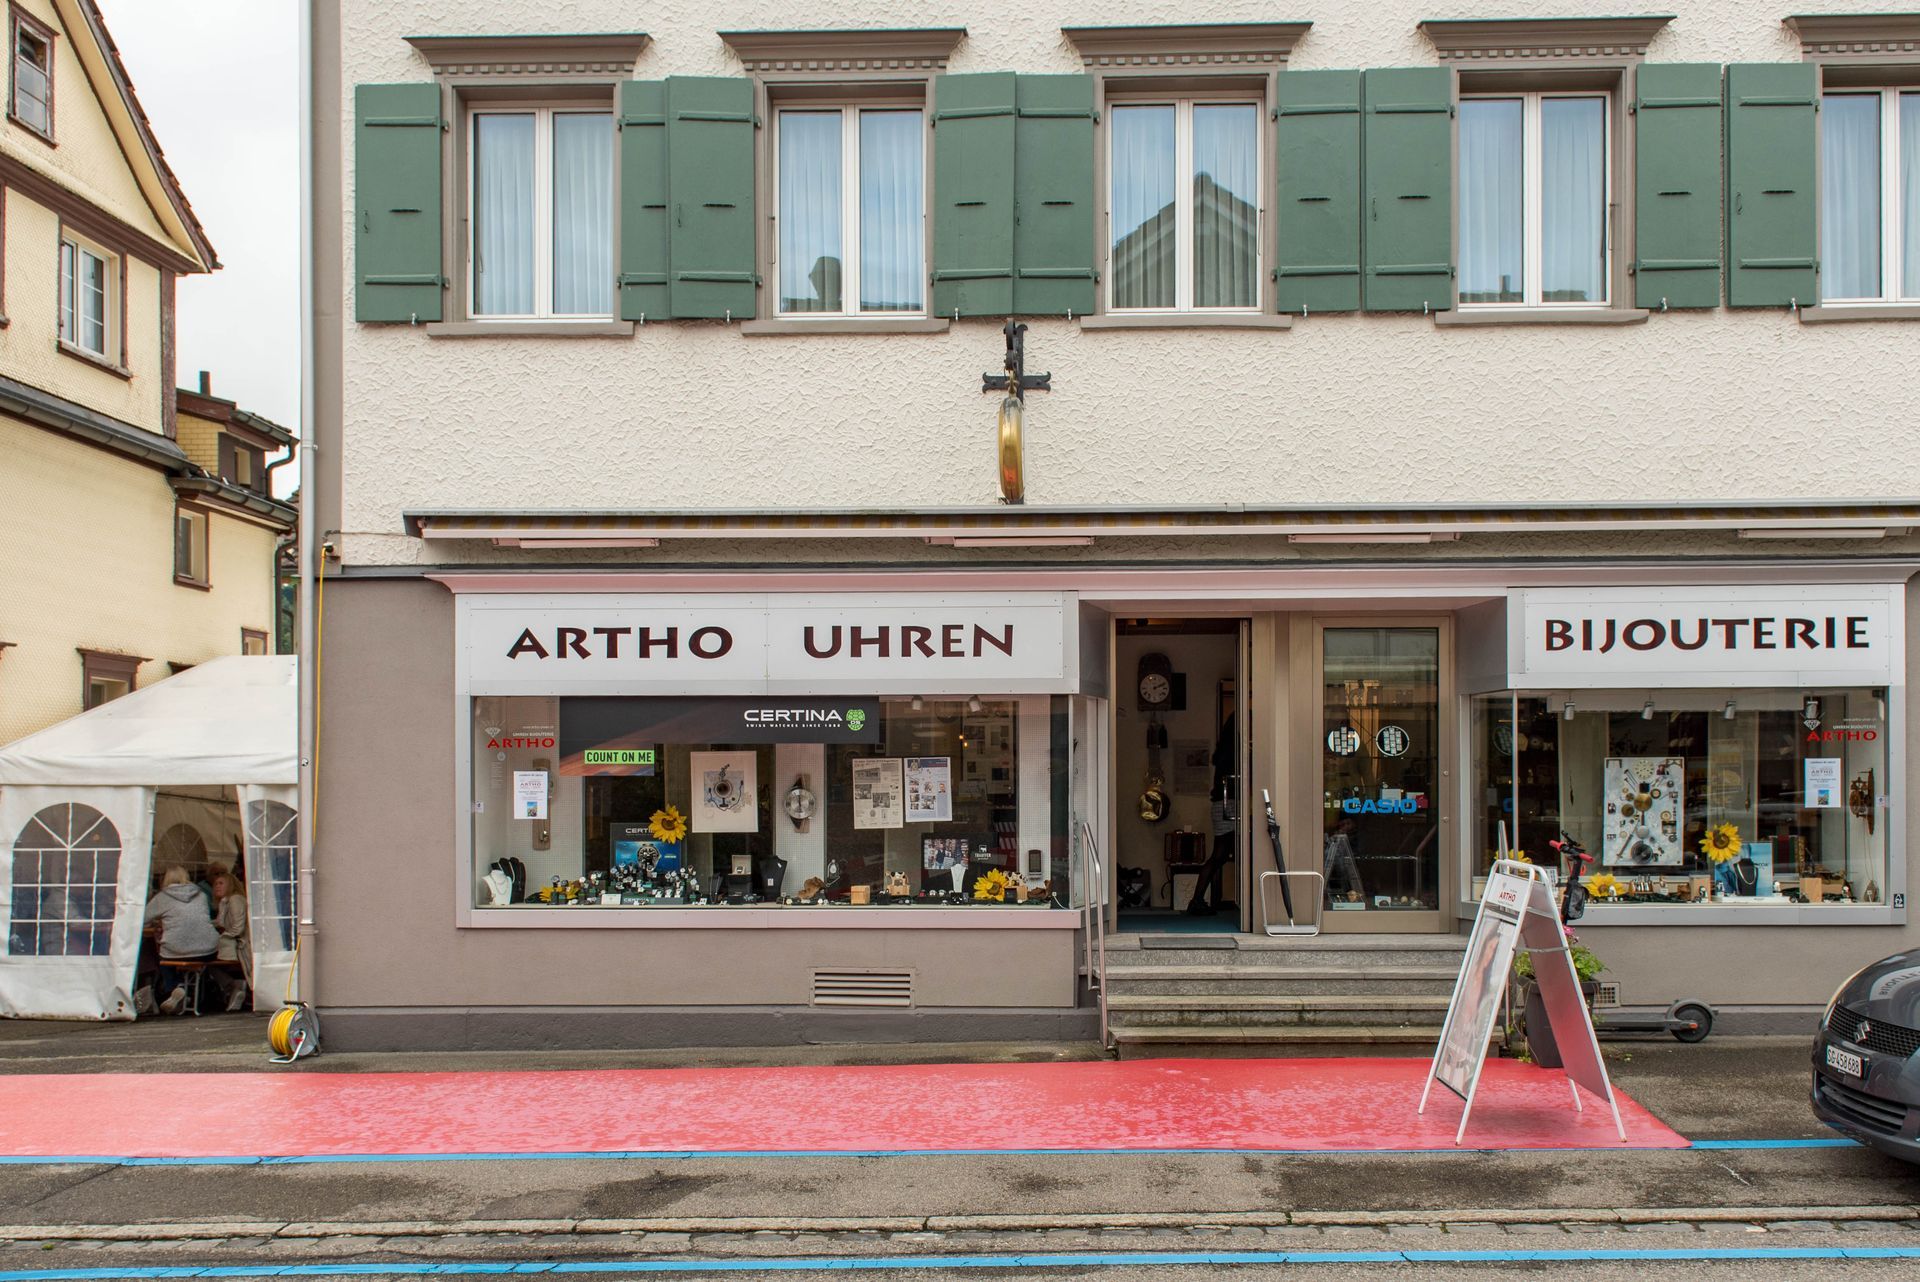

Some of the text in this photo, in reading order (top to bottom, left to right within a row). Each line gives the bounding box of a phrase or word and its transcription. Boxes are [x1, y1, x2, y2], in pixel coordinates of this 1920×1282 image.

[506, 623, 1015, 660] ARTHO UHREN
[1545, 616, 1870, 654] BIJOUTERIE
[744, 709, 843, 722] CERTINA
[1807, 730, 1877, 742] ARTHO
[487, 737, 555, 749] ARTHO
[586, 751, 652, 762] COUNT ON ME
[1343, 798, 1417, 814] CASIO
